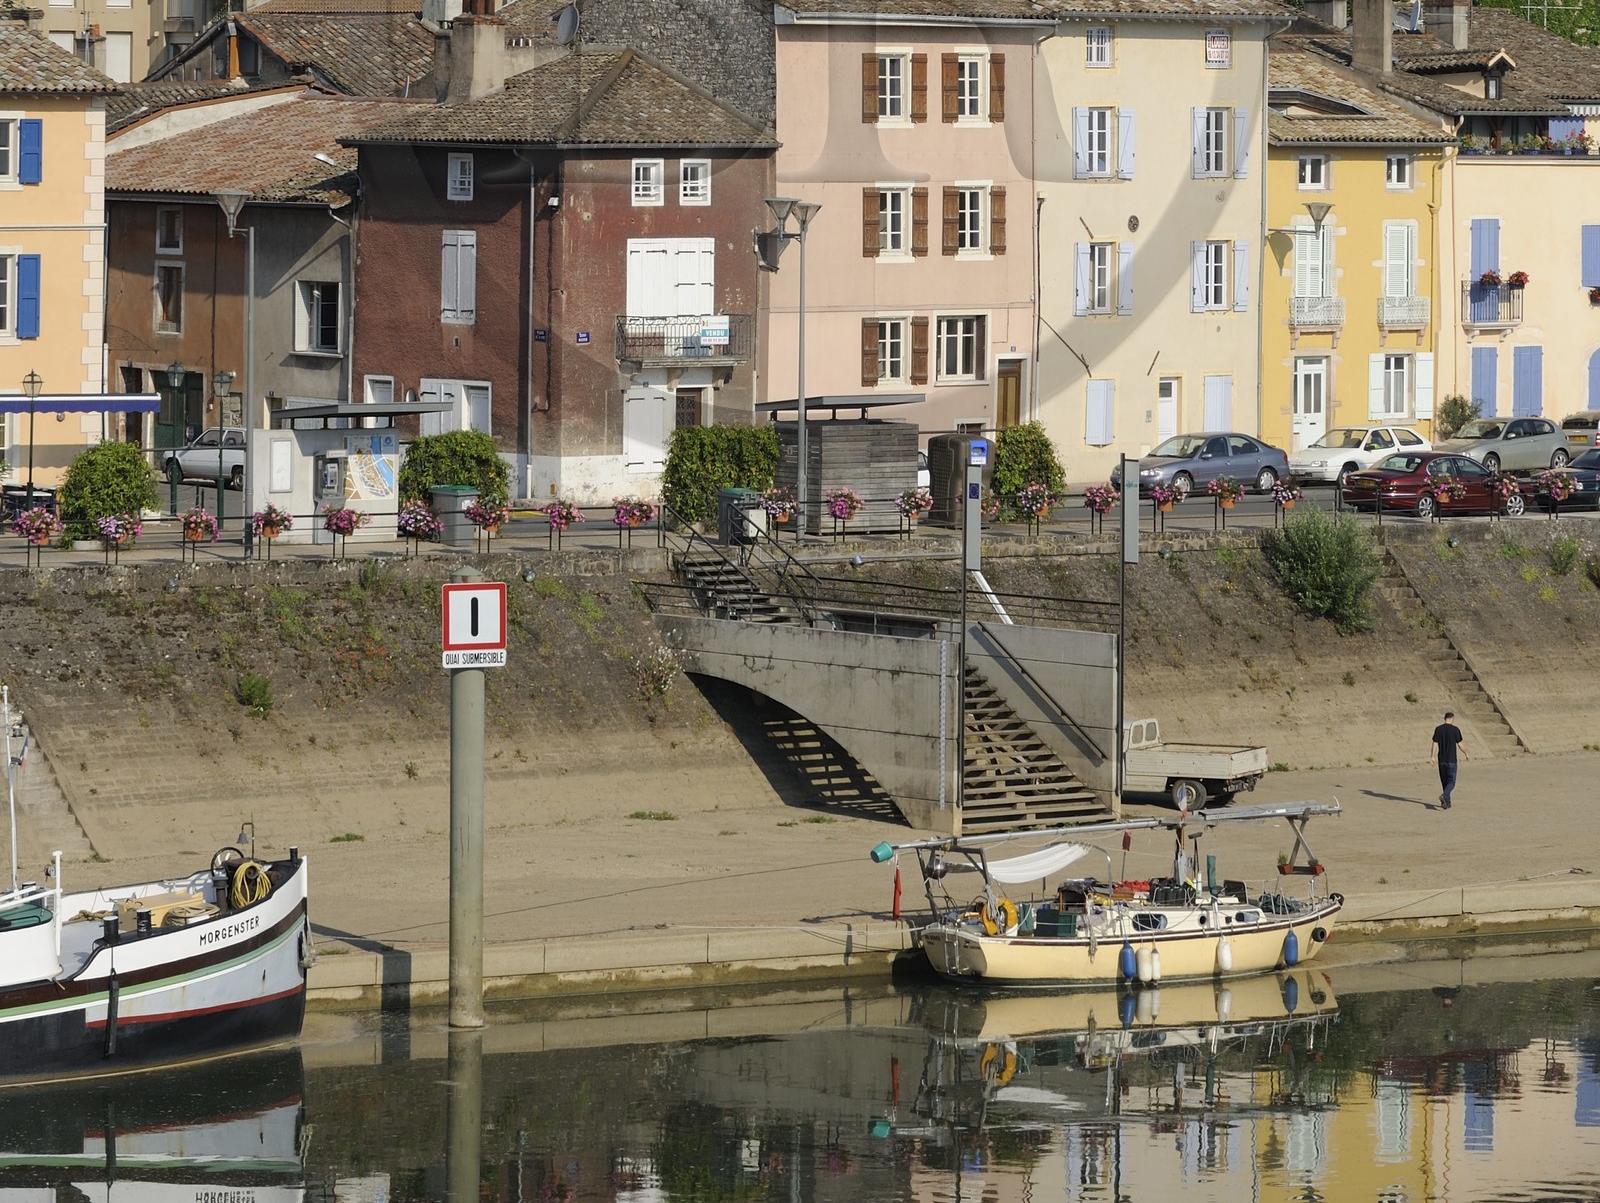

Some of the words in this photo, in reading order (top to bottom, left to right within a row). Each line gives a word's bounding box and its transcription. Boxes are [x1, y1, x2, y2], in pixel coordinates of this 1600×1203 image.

[1211, 37, 1228, 48] LOUER
[705, 329, 725, 337] VENDU
[445, 653, 460, 665] QUAI
[462, 652, 504, 665] SUBMERSIBLE
[199, 915, 260, 947] MORGENSTER
